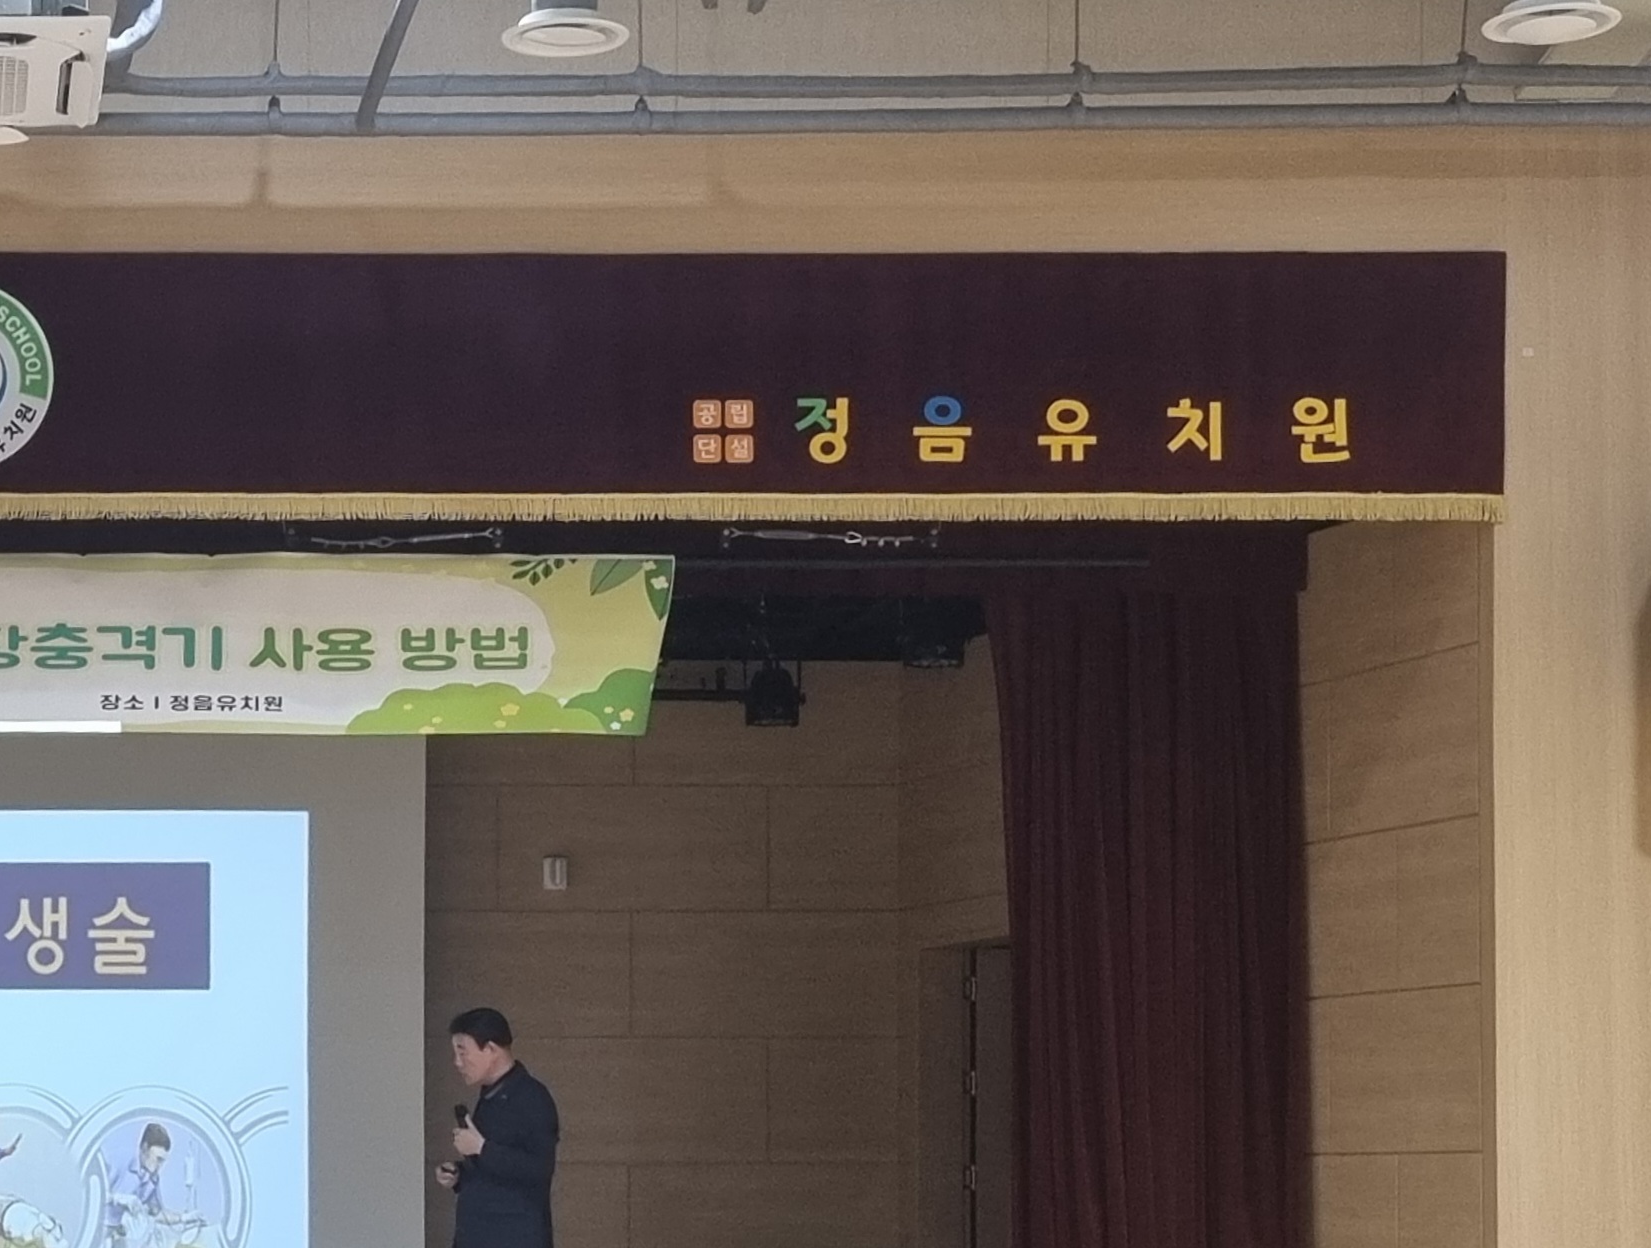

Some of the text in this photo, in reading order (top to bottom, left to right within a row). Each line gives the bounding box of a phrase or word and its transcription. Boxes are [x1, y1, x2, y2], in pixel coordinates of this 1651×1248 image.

[698, 403, 748, 424] 공립
[794, 396, 1351, 464] 정음유치원
[698, 438, 748, 459] 단설
[248, 626, 377, 672] 사용
[400, 625, 530, 672] 방법
[99, 693, 145, 711] 장소
